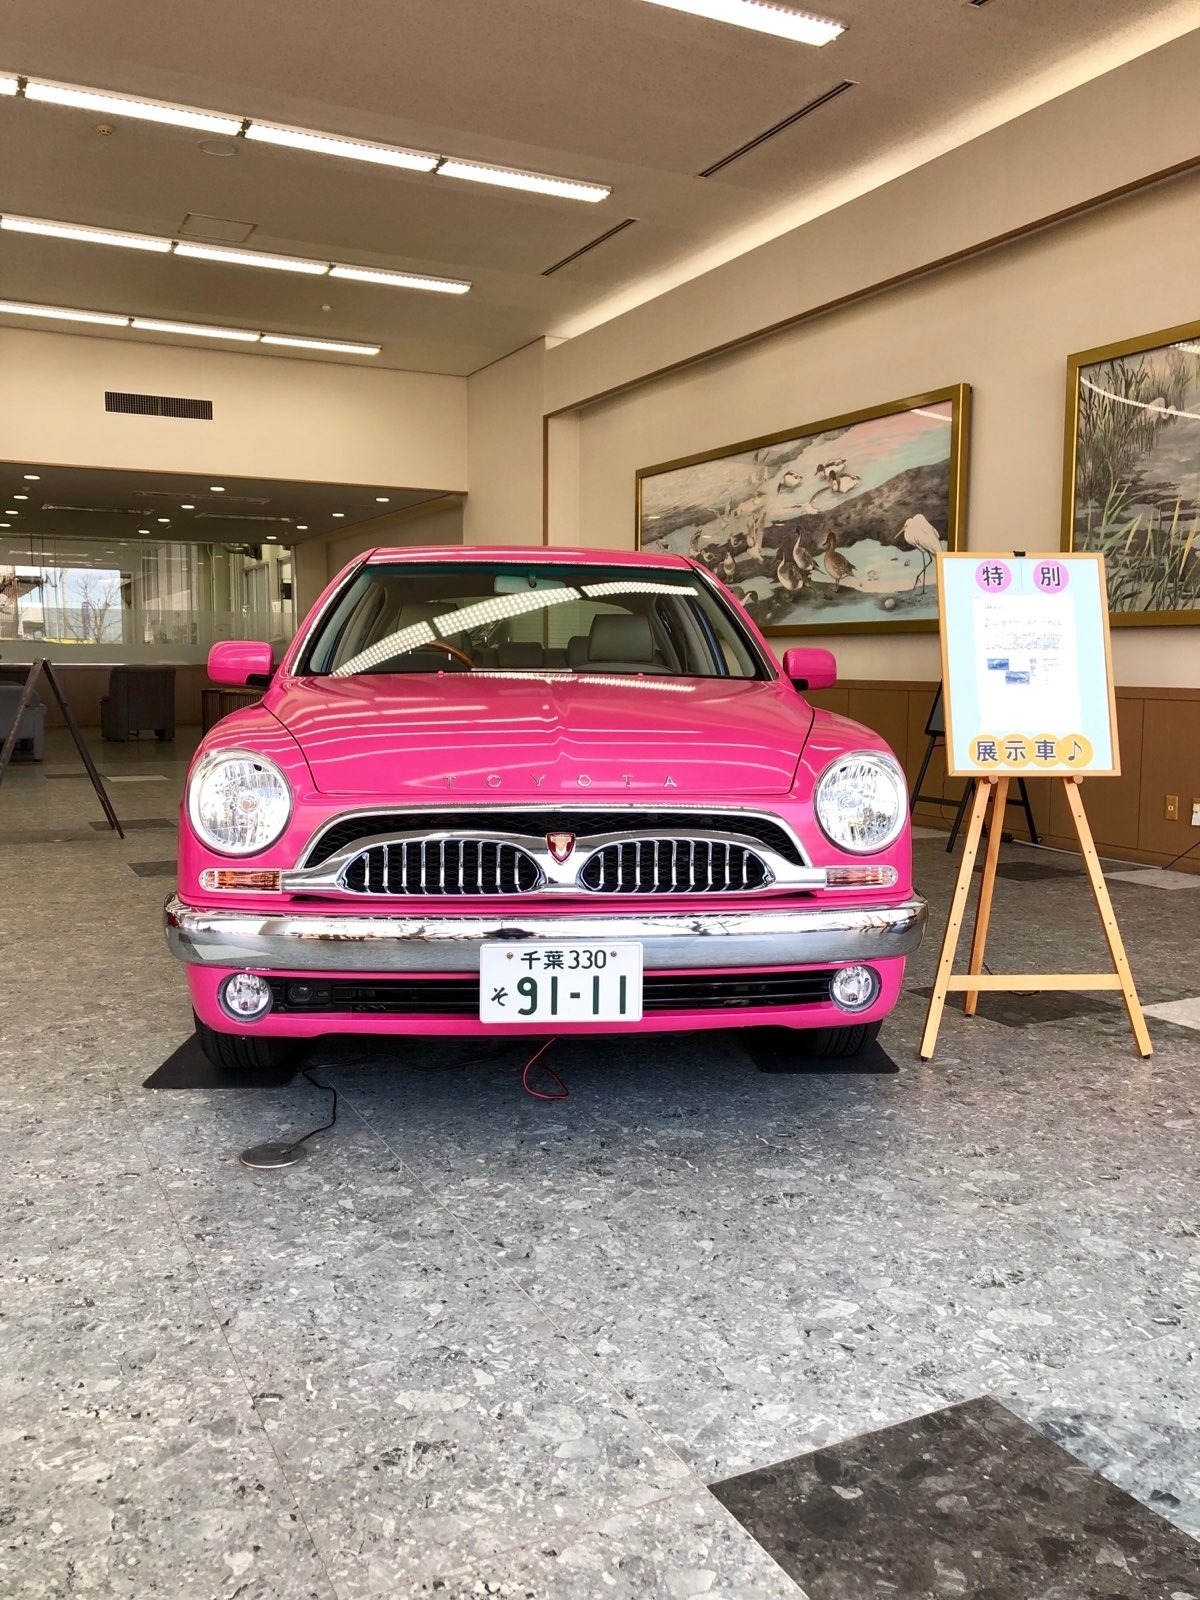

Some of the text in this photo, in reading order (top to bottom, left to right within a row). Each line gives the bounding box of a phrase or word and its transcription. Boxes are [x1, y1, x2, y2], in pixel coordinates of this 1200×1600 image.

[443, 774, 678, 788] TOYOTA
[491, 975, 626, 1016] そ 91-11
